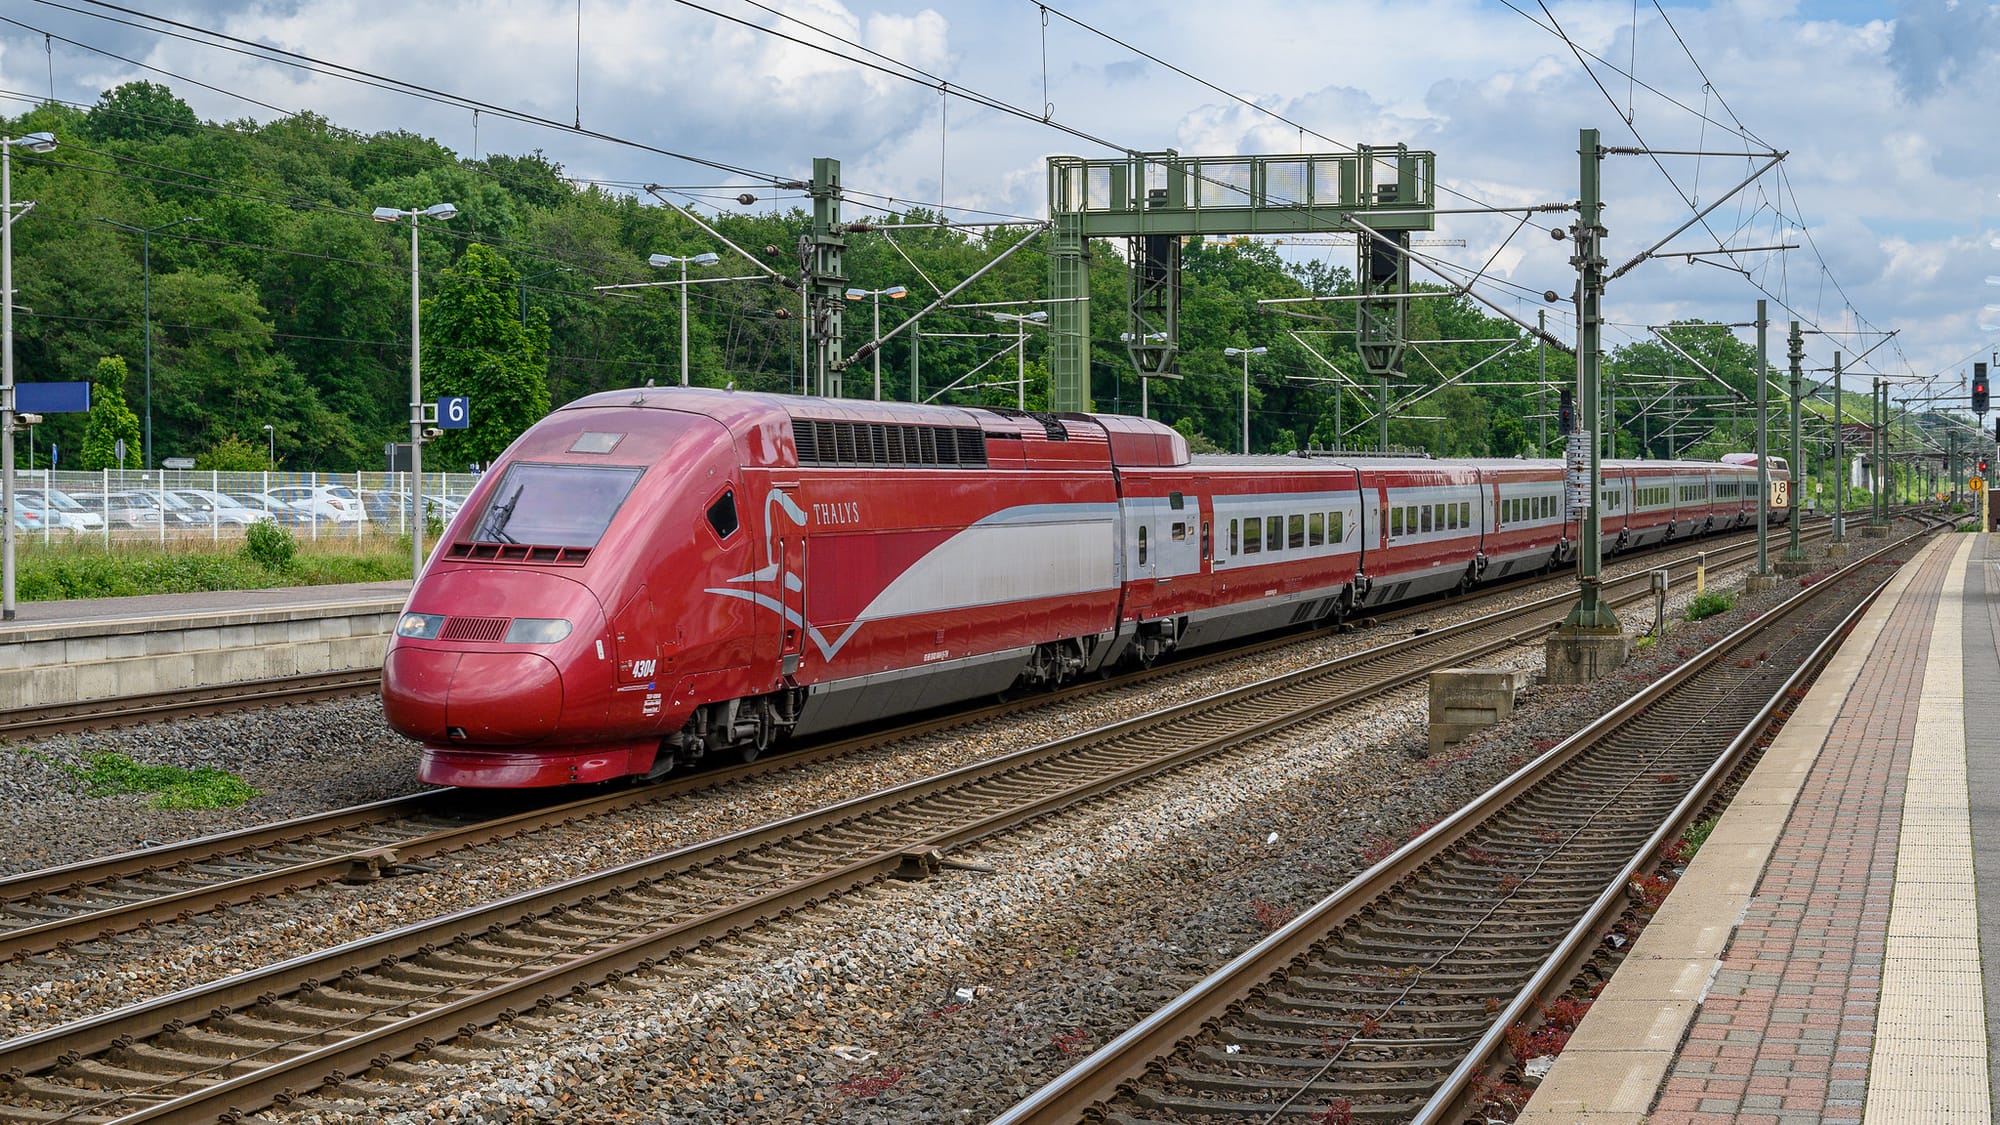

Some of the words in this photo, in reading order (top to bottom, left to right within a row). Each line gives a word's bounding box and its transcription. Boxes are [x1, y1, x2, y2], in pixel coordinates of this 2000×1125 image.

[449, 398, 463, 422] 6
[1773, 482, 1786, 493] 18
[1776, 493, 1783, 505] 6
[813, 501, 859, 525] THALYS
[632, 659, 657, 678] 4304
